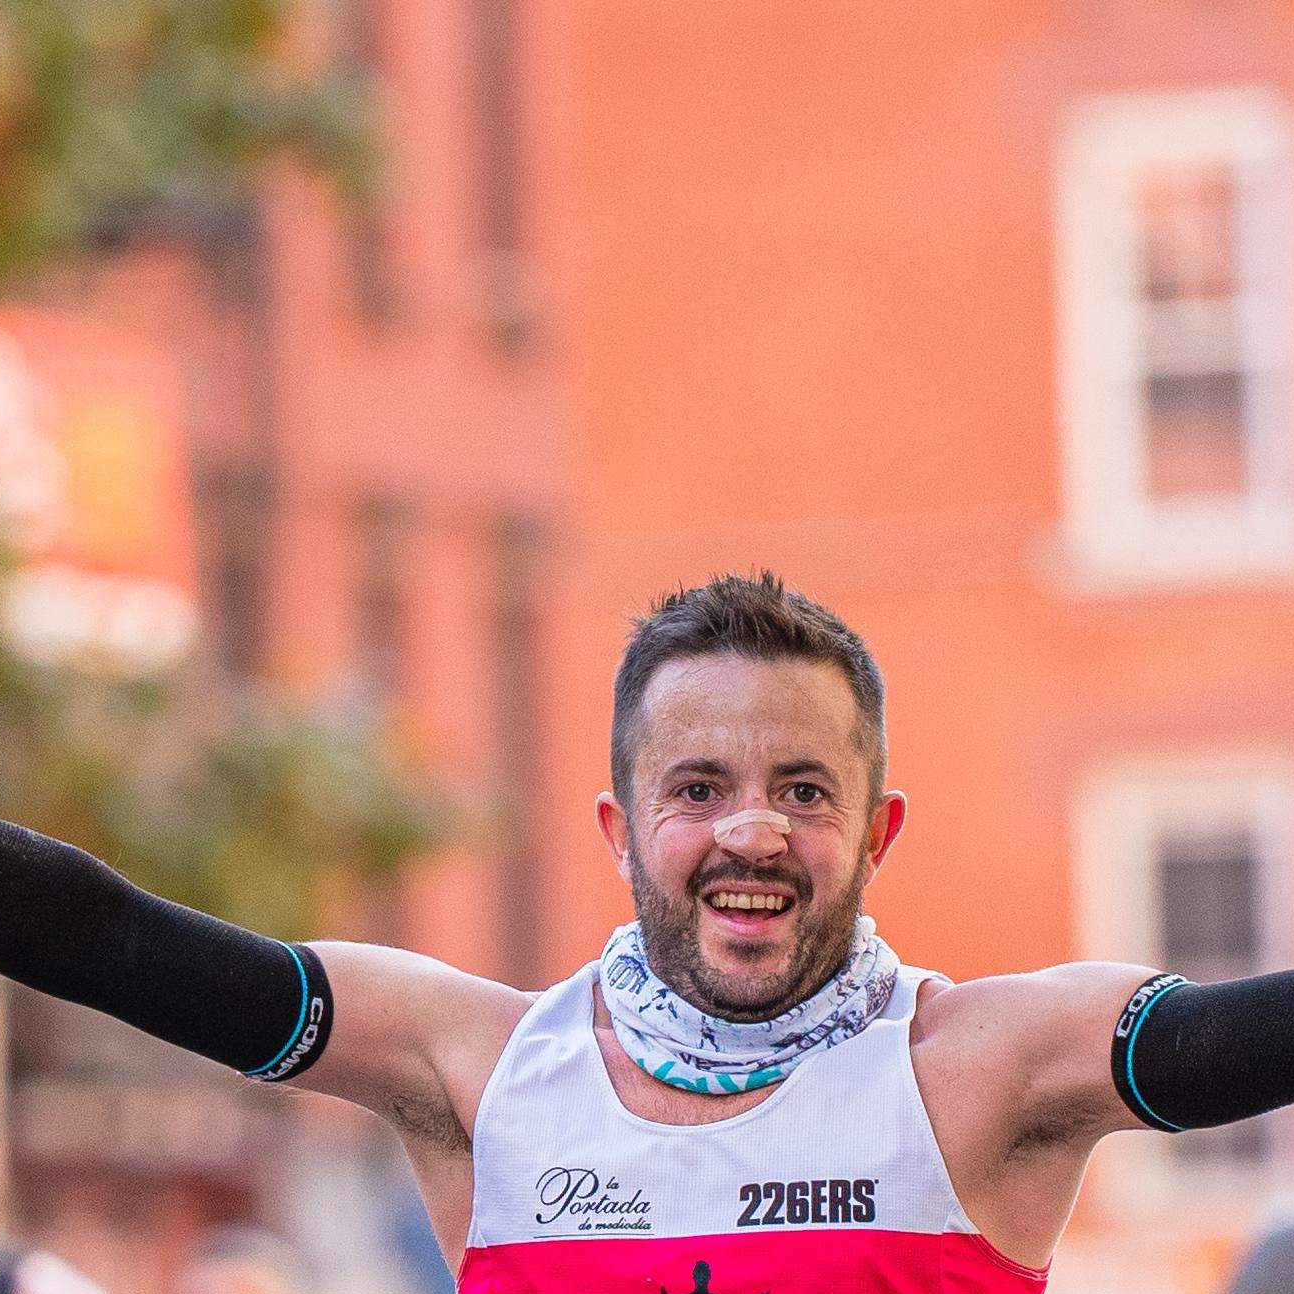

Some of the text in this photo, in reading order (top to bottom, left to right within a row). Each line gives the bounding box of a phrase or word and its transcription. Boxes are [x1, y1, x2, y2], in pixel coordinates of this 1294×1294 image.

[535, 1166, 652, 1225] Portada
[606, 1176, 620, 1190] la
[736, 1178, 877, 1227] 226ERS
[578, 1217, 592, 1231] de
